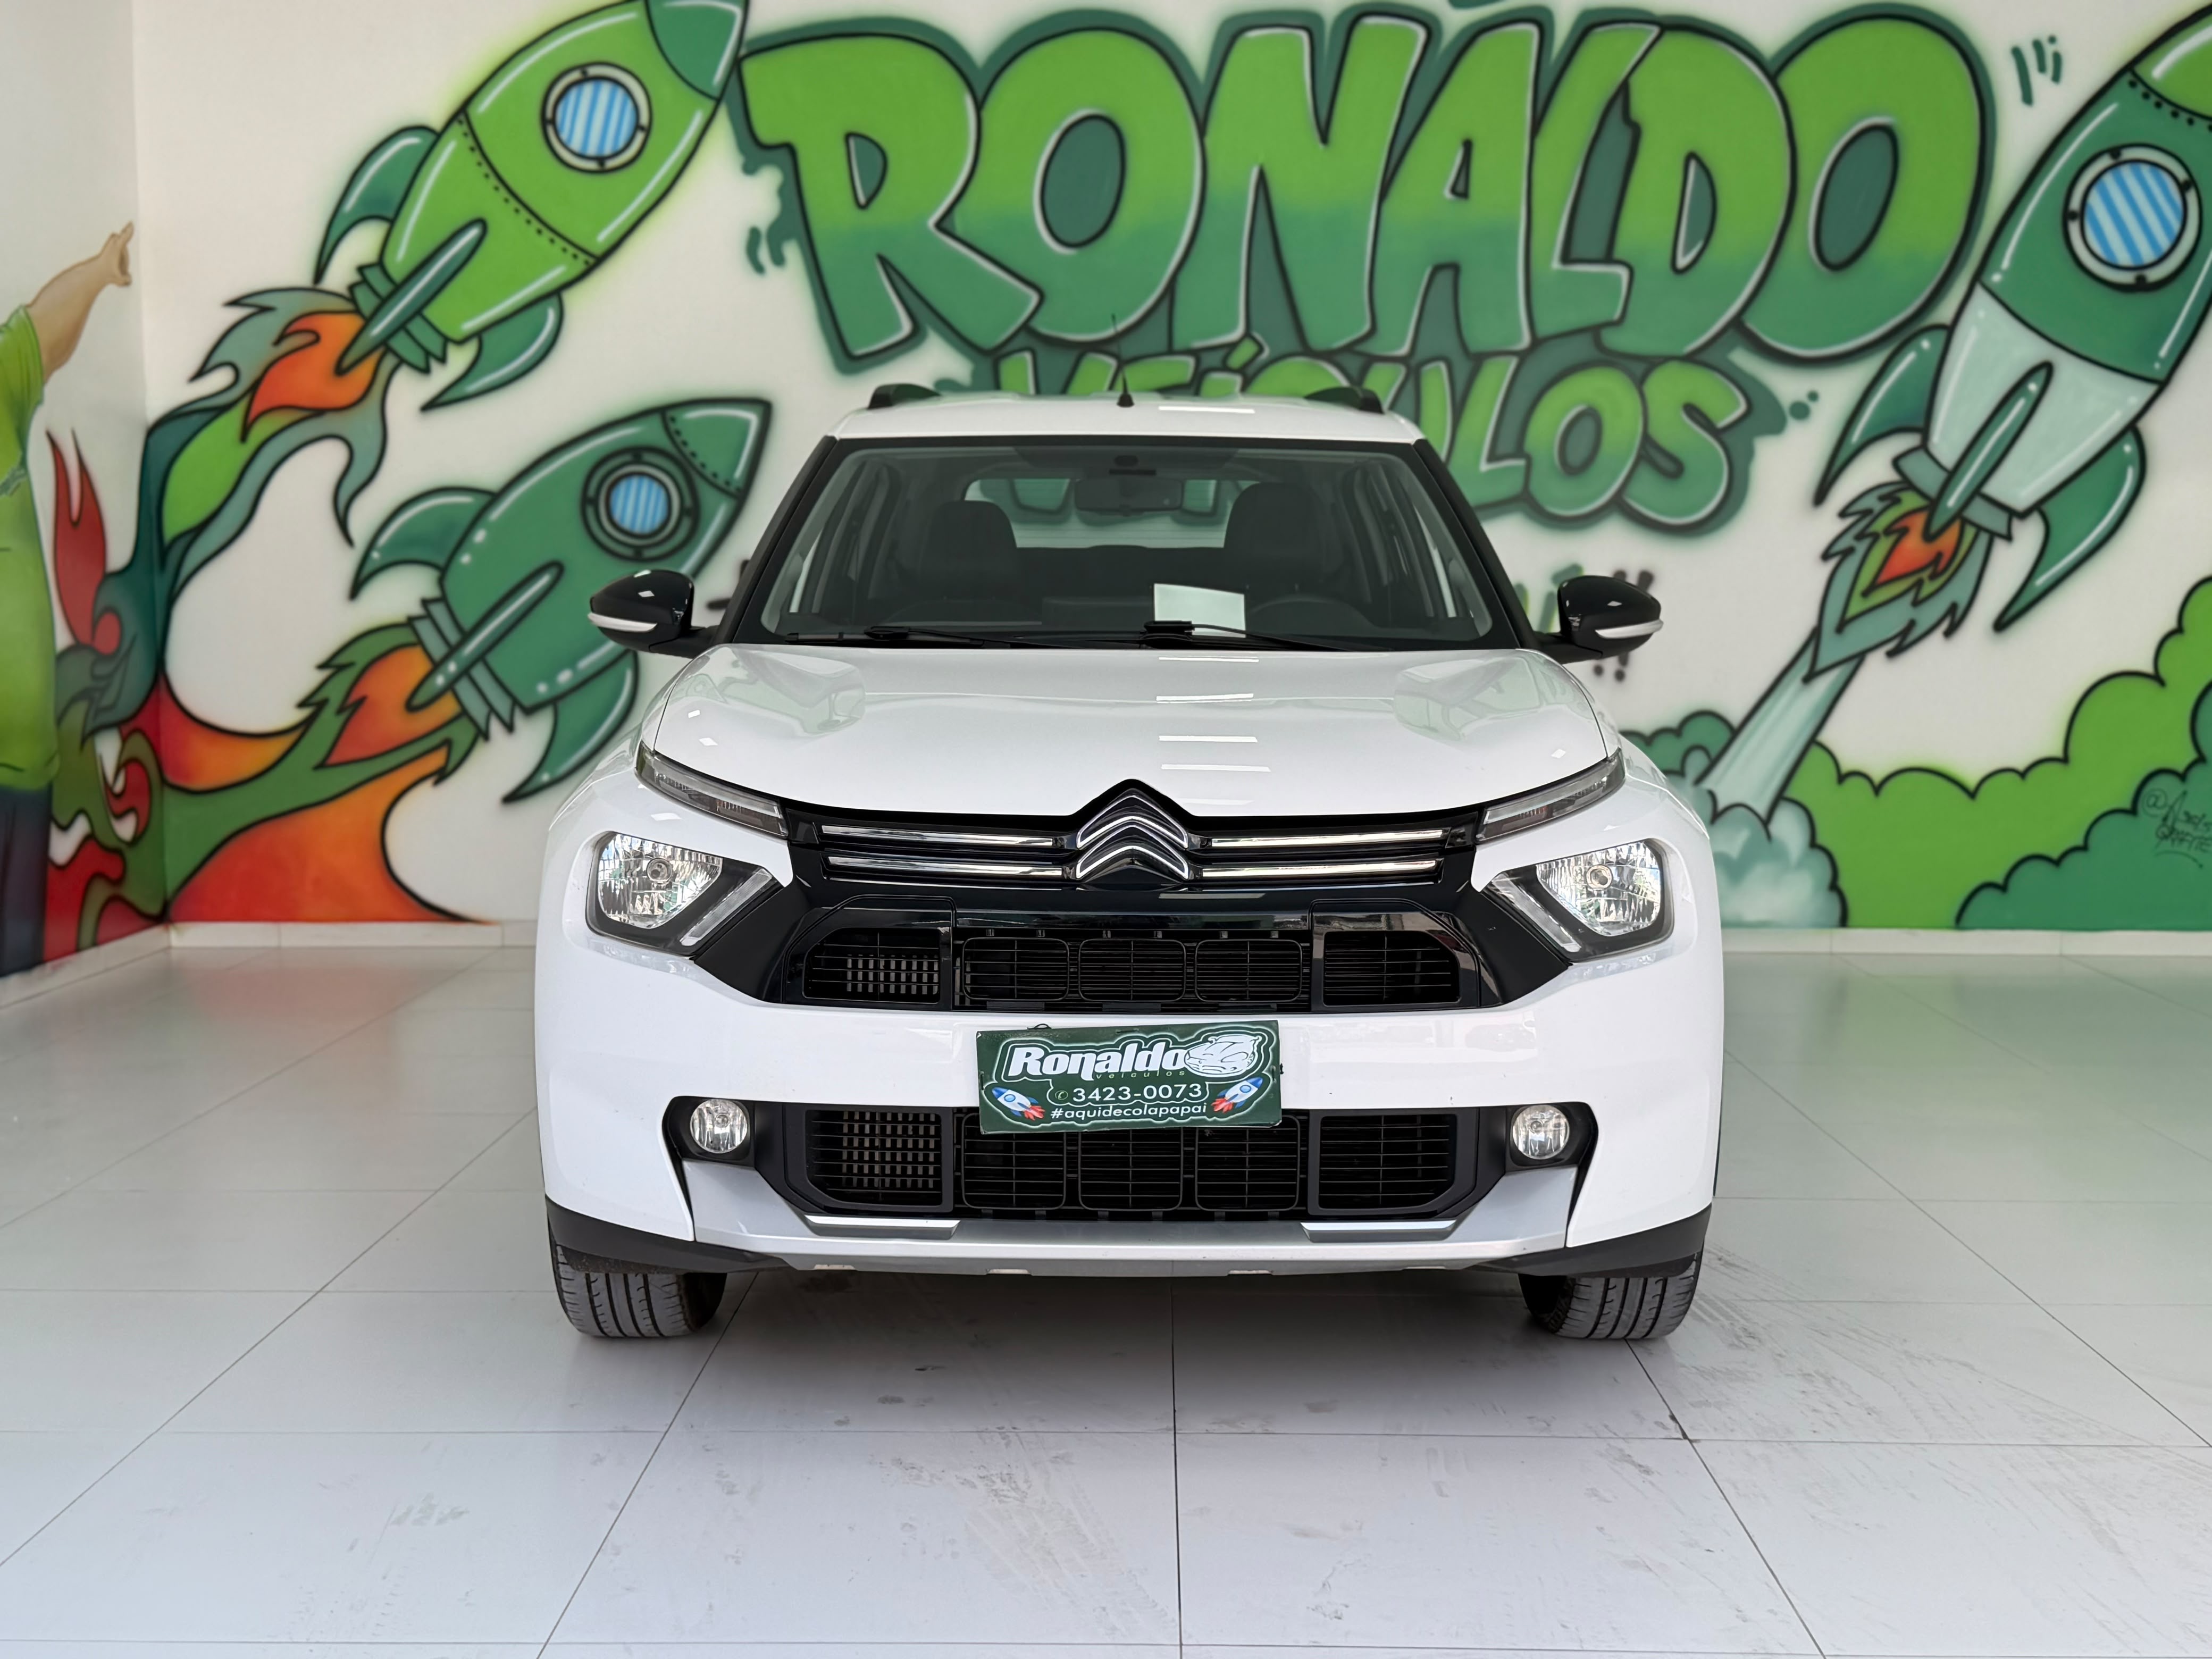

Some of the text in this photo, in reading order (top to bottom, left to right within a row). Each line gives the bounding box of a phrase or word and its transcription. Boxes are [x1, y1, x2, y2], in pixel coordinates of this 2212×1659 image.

[737, 12, 1989, 358] RONALDO
[1008, 1042, 1187, 1081] Ronaldo
[1073, 1083, 1202, 1102] 3423-0073
[1050, 1103, 1207, 1120] #aquidecolapapai
